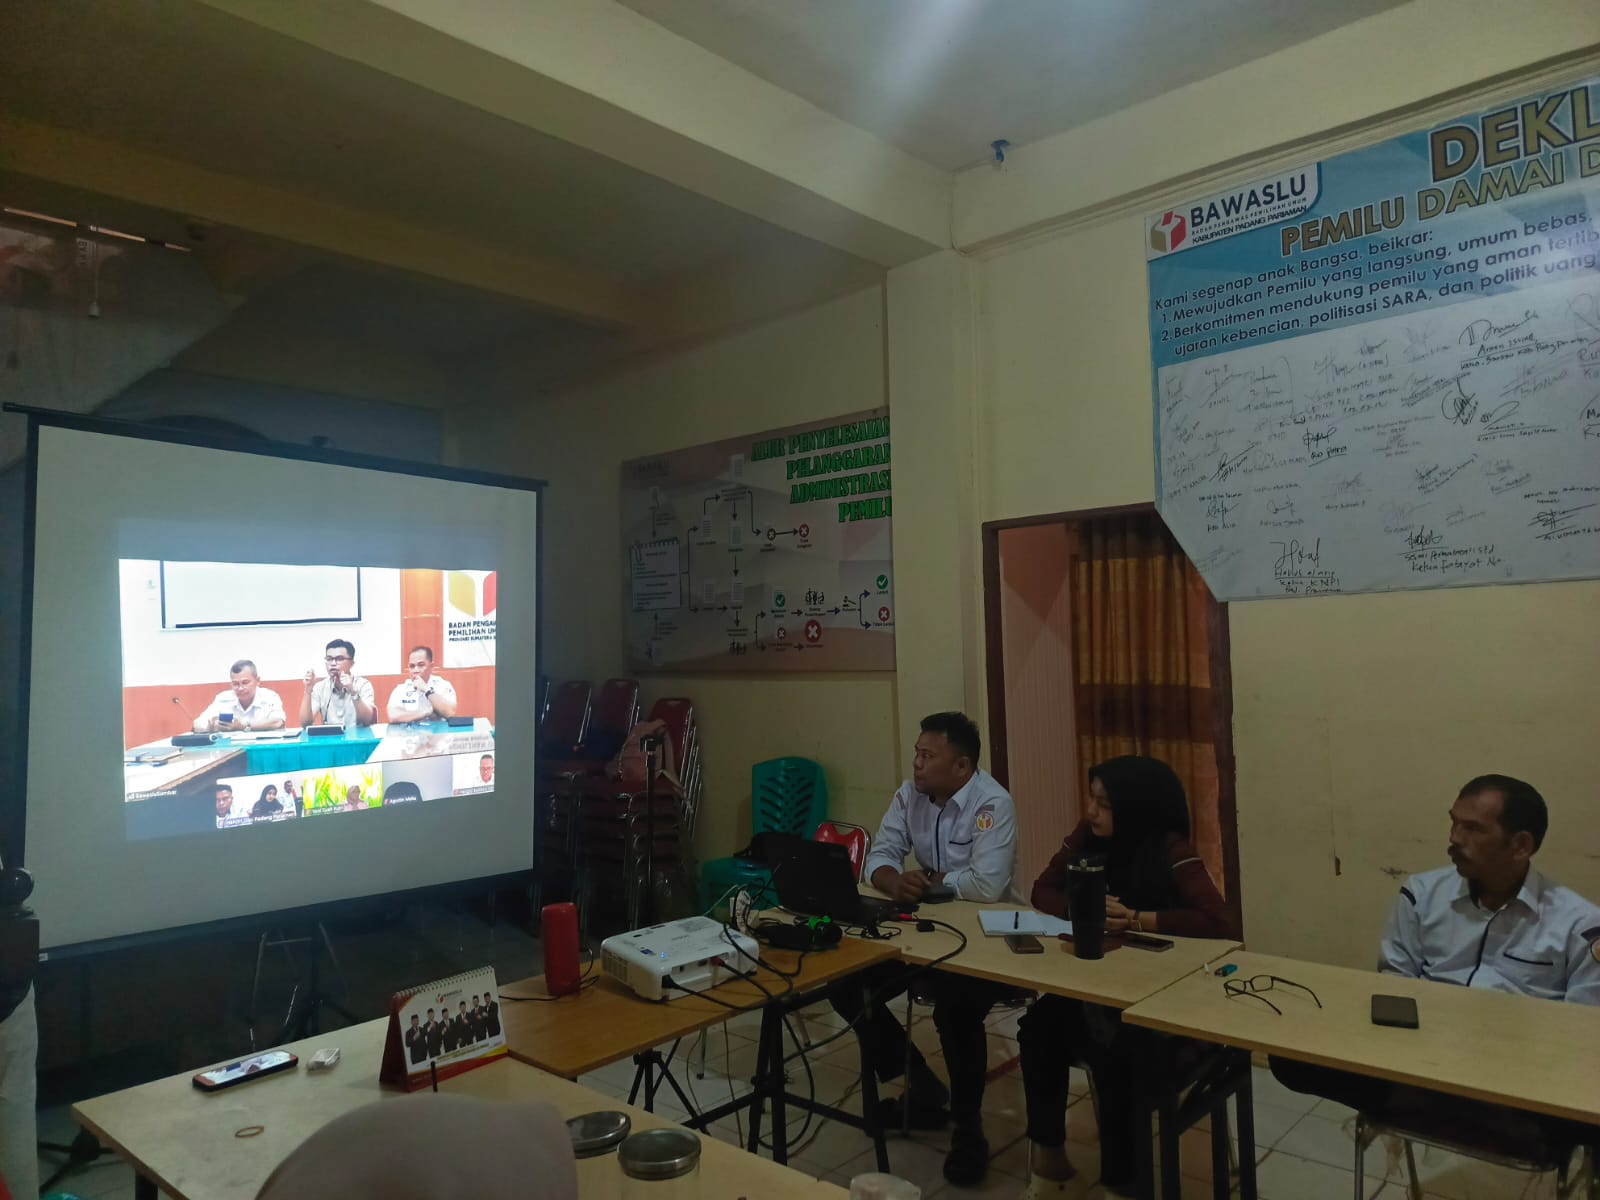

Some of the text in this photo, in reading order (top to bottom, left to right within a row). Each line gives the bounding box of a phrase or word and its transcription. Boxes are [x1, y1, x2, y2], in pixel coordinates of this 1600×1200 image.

[1429, 86, 1600, 183] DEKL
[1191, 173, 1306, 228] BAWASLU
[1192, 223, 1234, 245] KABUPATEN
[1235, 215, 1266, 232] PADANG
[1281, 196, 1405, 257] PEMILU
[1417, 151, 1565, 221] DAMAI
[1155, 230, 1433, 310] Kami segenap anak Bangsa, beikrar:
[1267, 277, 1316, 297] Pemilu
[1322, 265, 1362, 287] yang
[1368, 245, 1452, 272] langsung,
[1458, 229, 1517, 252] umum
[1523, 211, 1592, 236] bebas,
[1270, 284, 1363, 315] mendukung
[1369, 271, 1426, 296] pemilu
[1432, 259, 1479, 281] yang
[1485, 243, 1541, 266] aman
[1174, 254, 1596, 356] ujaran kebencian, politisasi SARA, dan politik uang
[448, 621, 471, 629] BADAN
[448, 628, 486, 636] PEMILIHAN
